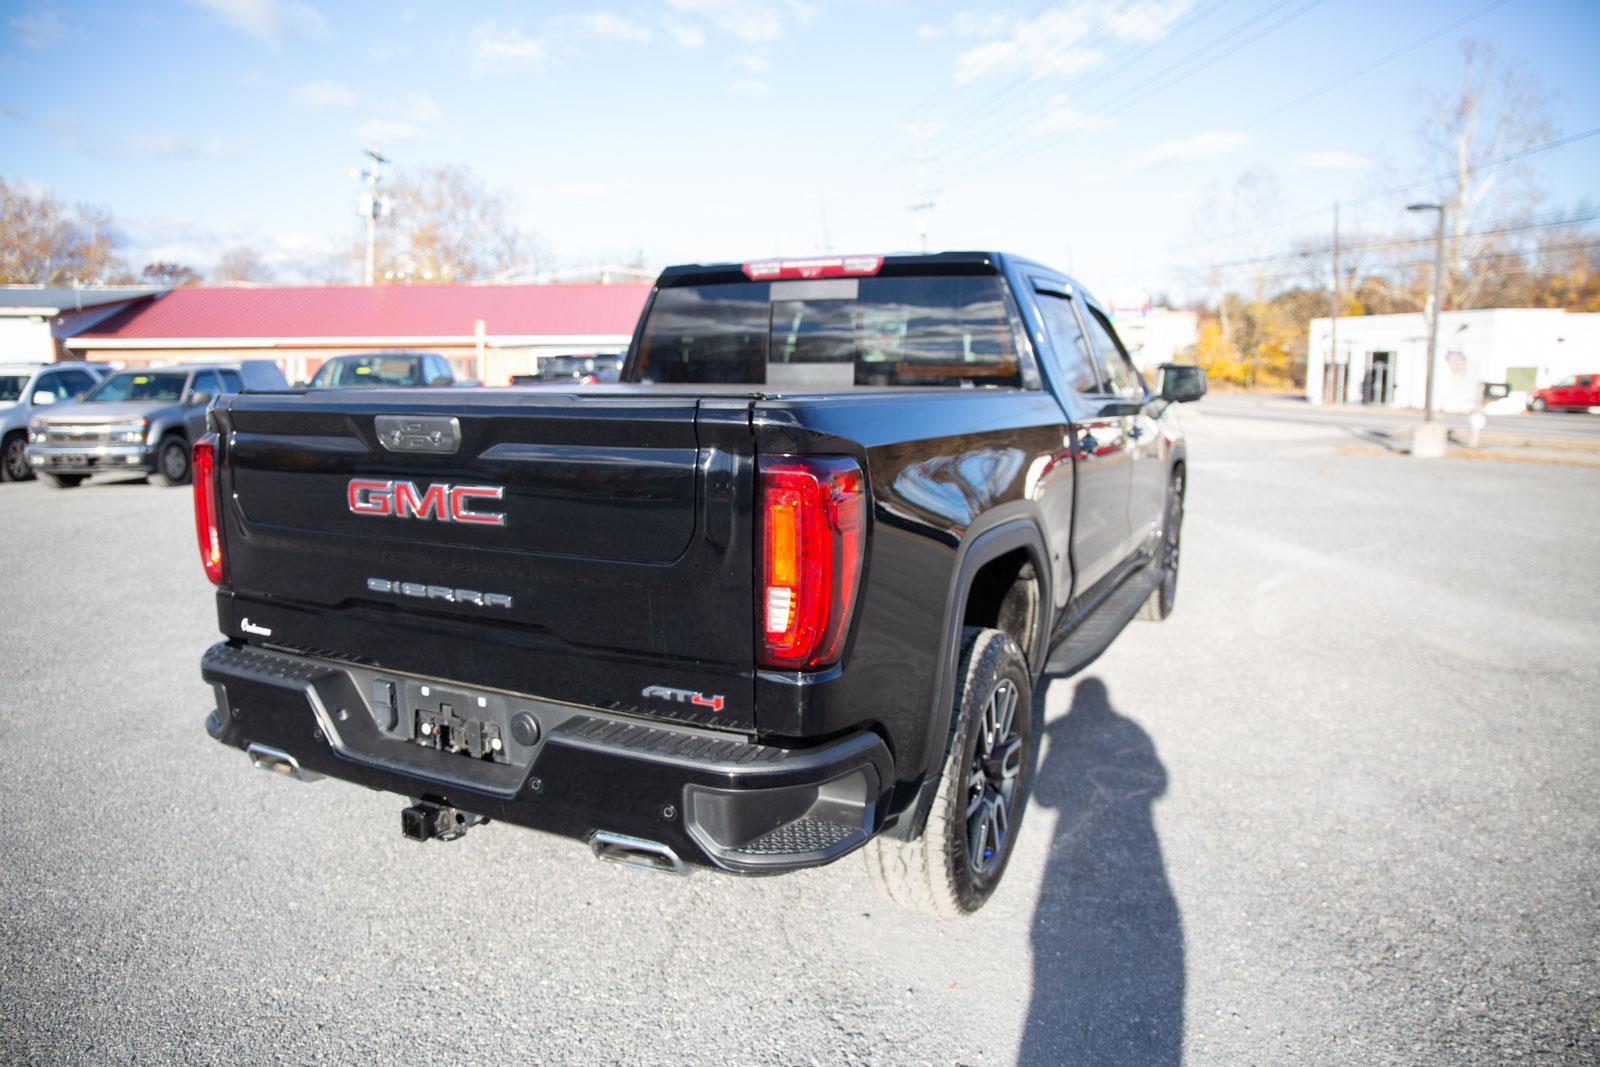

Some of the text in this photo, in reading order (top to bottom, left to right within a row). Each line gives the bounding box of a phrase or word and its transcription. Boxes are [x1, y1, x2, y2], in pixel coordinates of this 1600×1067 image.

[347, 478, 506, 527] GMC
[367, 577, 512, 608] SIERRA
[642, 685, 724, 712] AT4
